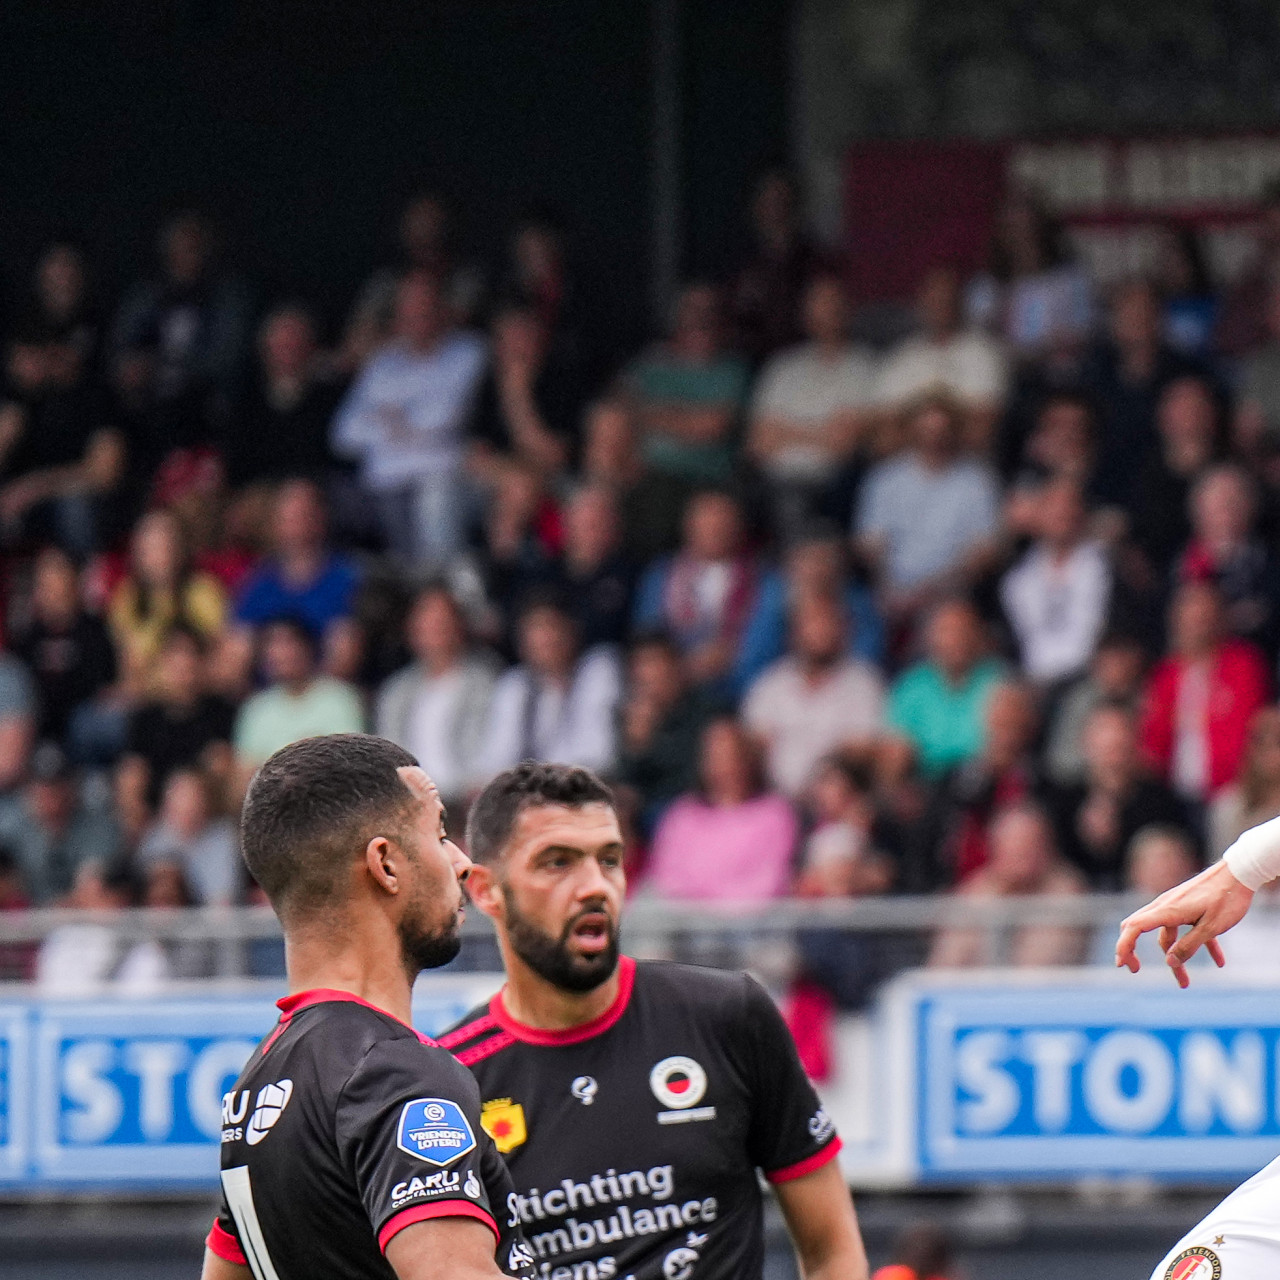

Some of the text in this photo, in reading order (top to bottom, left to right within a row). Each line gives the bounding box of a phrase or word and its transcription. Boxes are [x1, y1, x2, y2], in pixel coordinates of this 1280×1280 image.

[408, 1130, 466, 1141] VRIENDEN
[417, 1139, 461, 1150] LOTERIJ
[391, 1171, 459, 1200] CARU
[392, 1185, 460, 1208] CONTAINERS
[517, 1164, 675, 1224] tichting
[1181, 1248, 1221, 1279] FEYENOORD
